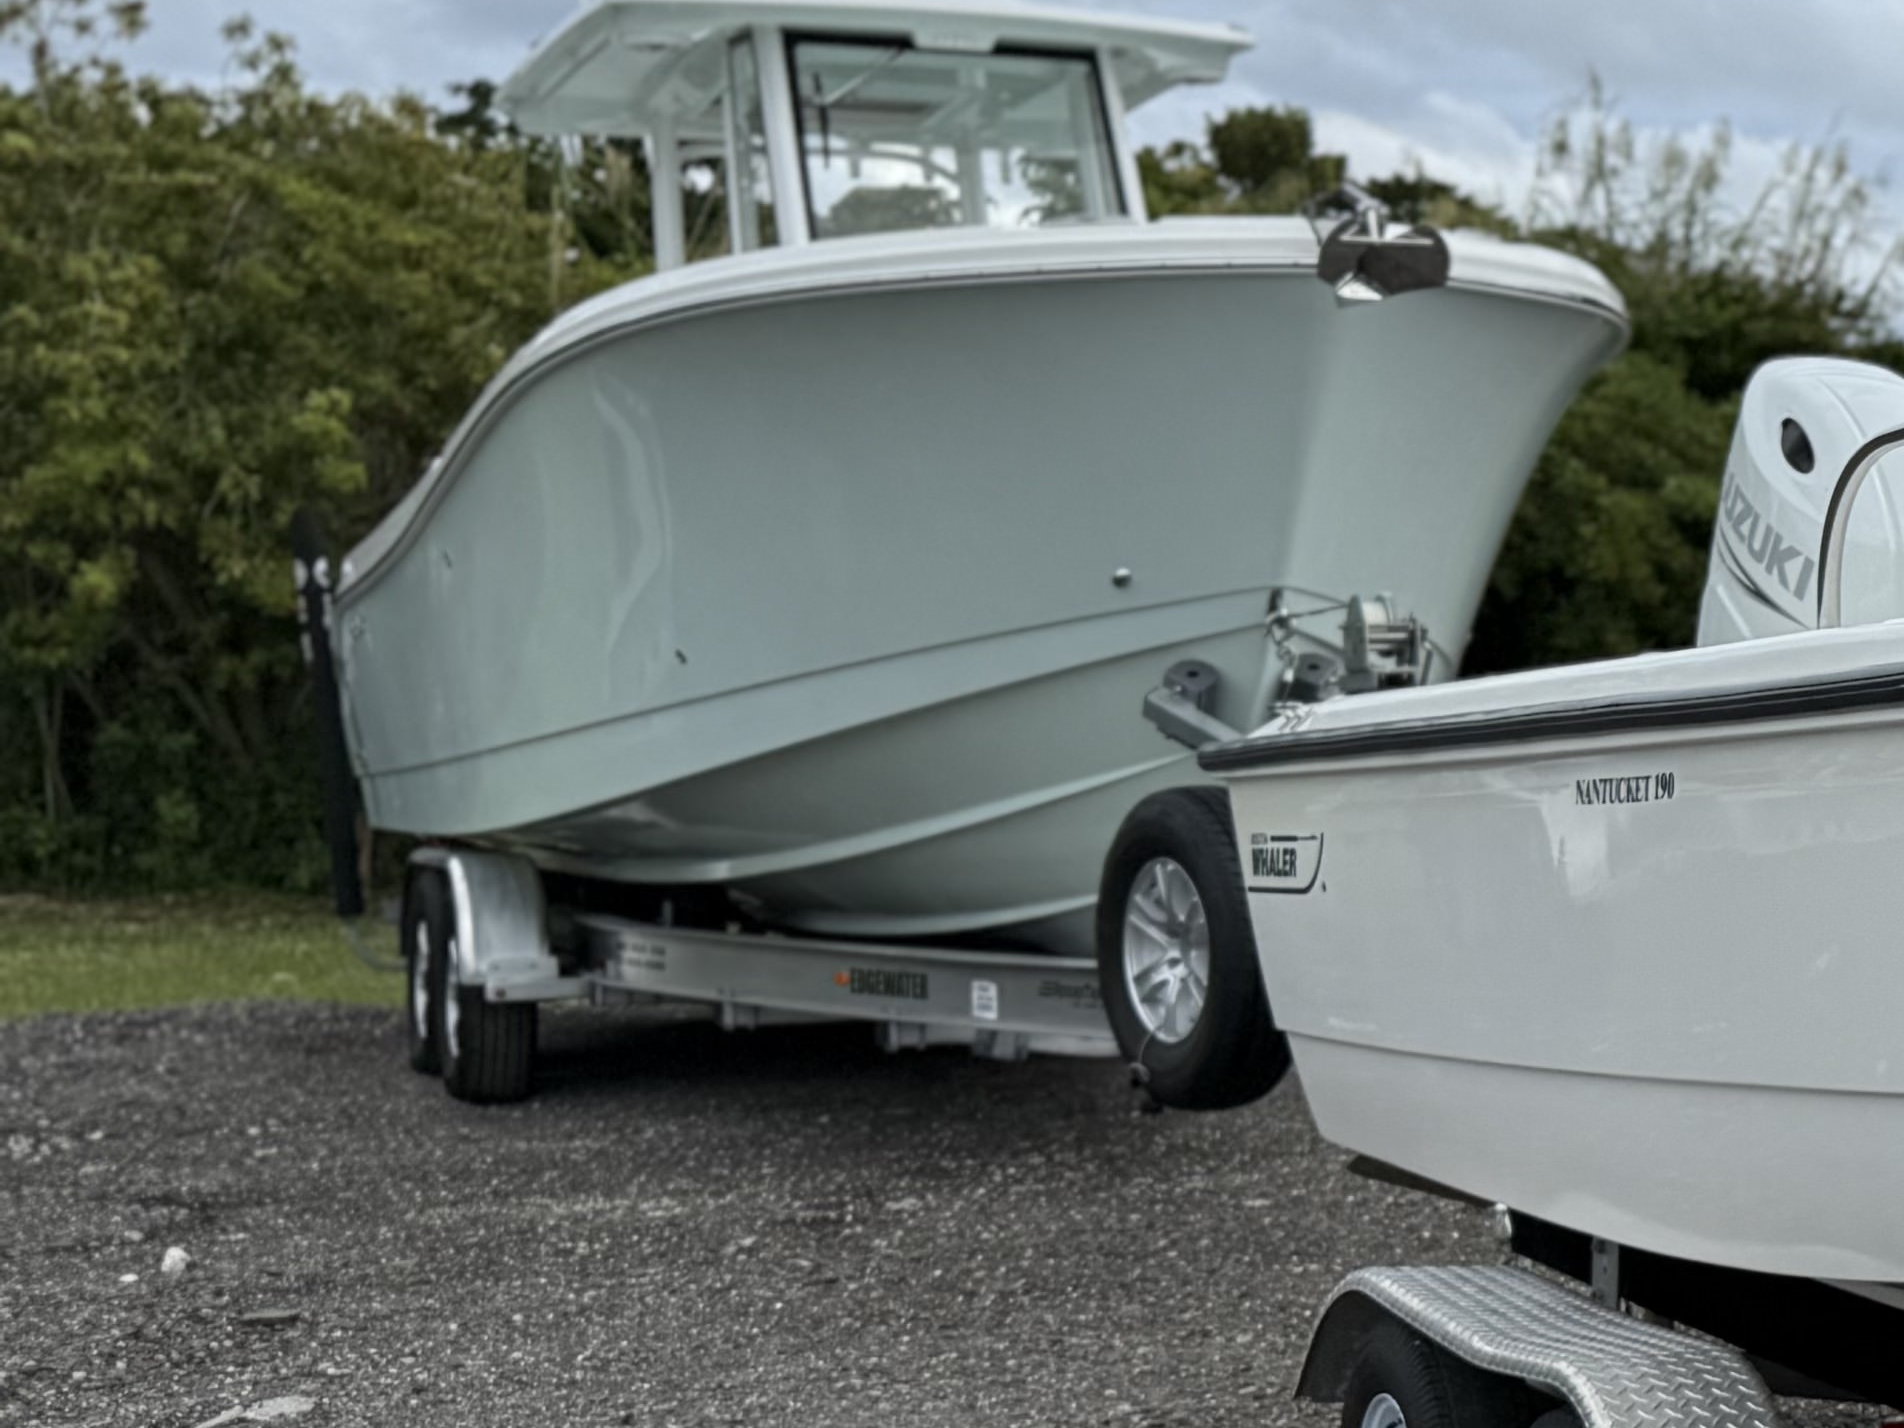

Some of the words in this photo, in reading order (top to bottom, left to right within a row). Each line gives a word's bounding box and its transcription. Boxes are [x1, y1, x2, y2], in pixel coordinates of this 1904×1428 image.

[1722, 472, 1816, 602] UZUKI
[1575, 774, 1651, 806] NANTUCKET
[1653, 771, 1675, 801] 190
[1251, 847, 1297, 878] WHALER
[849, 967, 929, 1000] EDGEWATER
